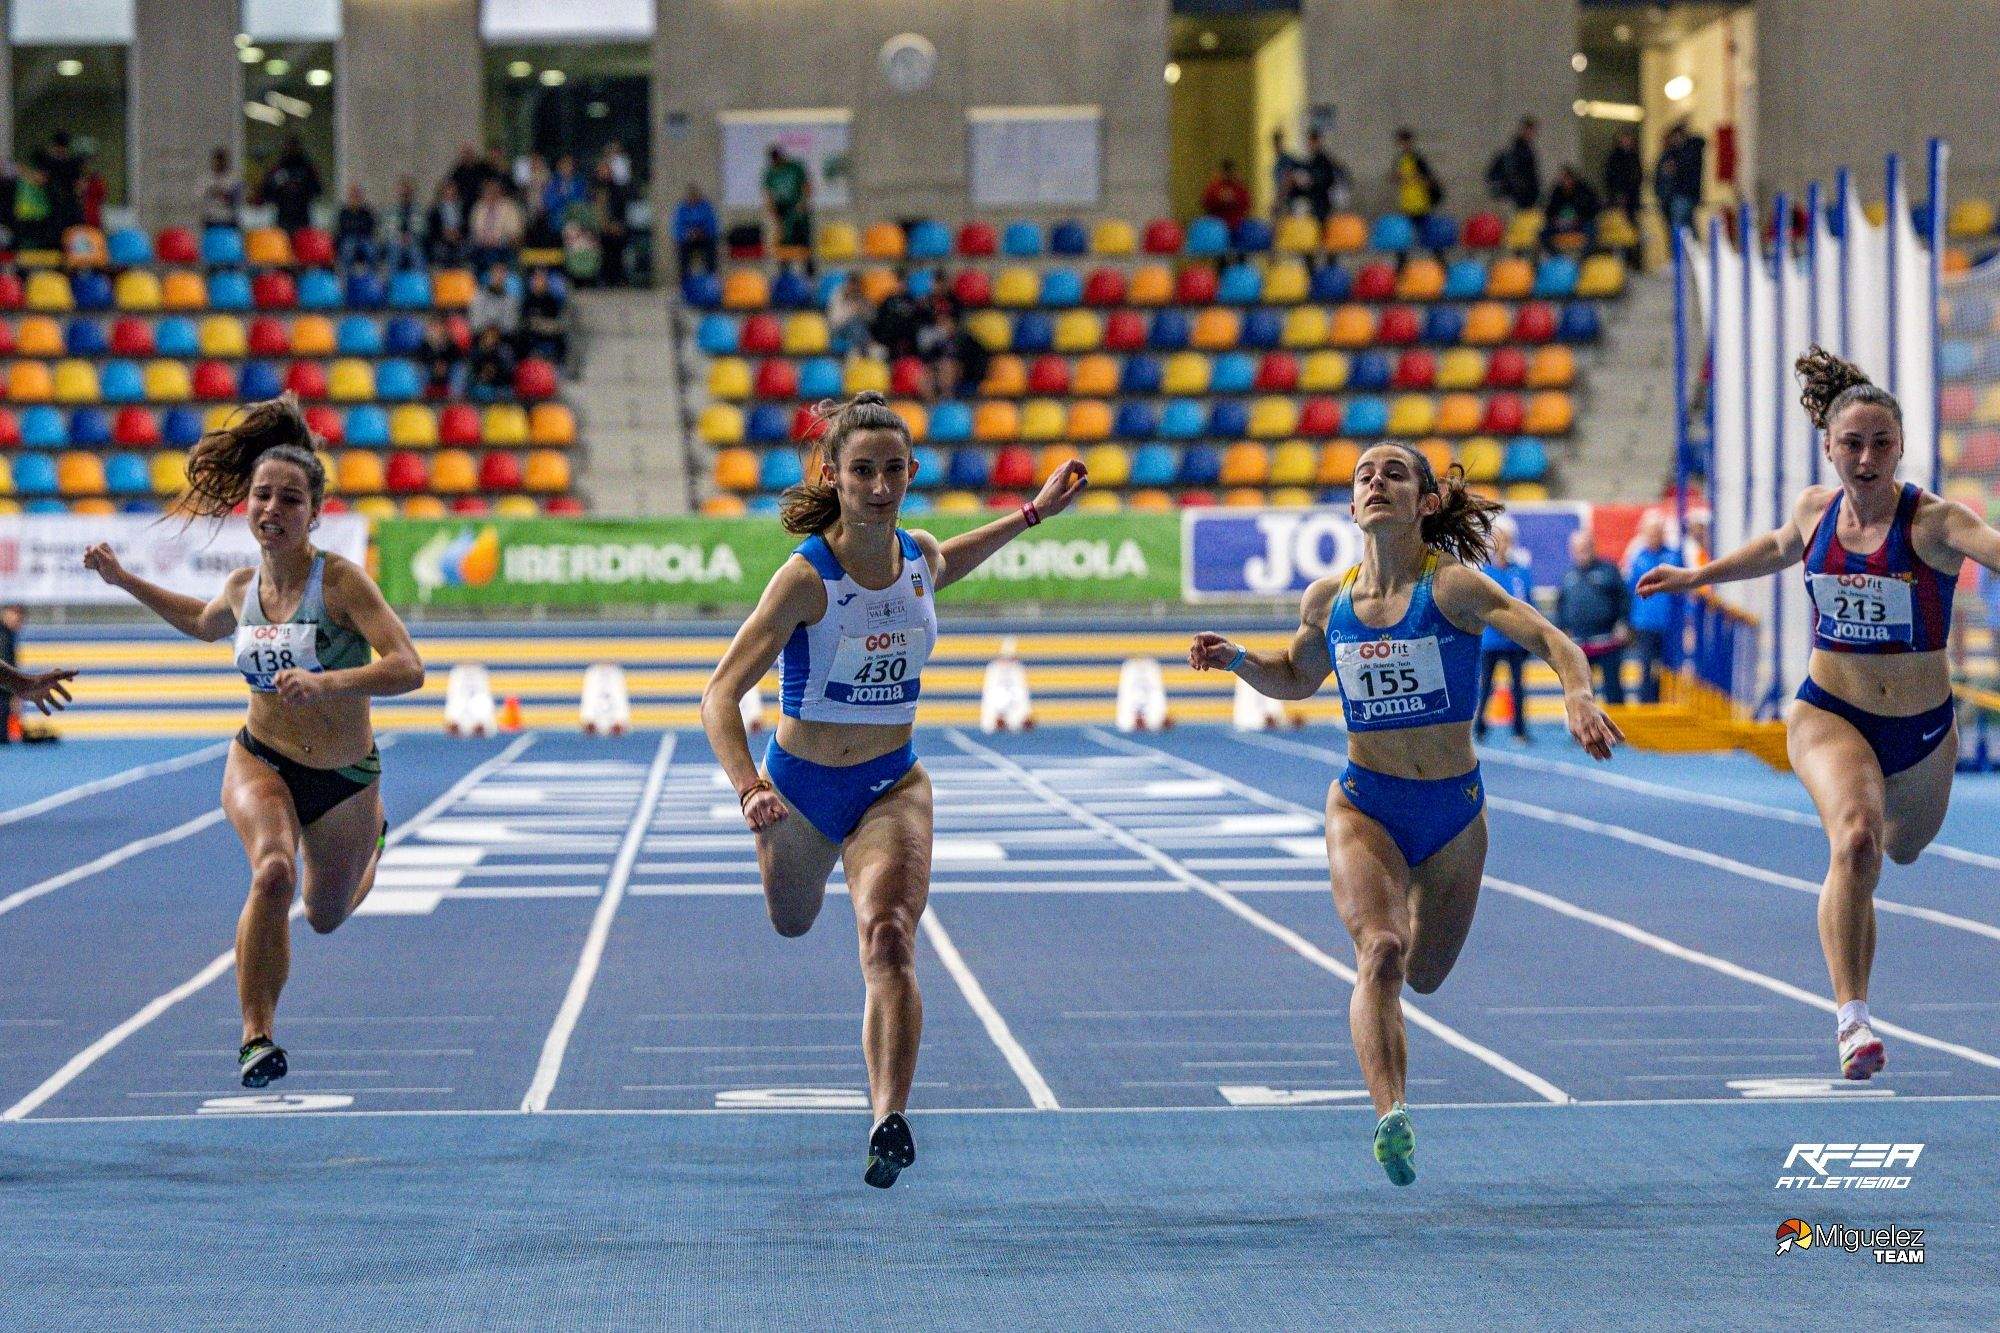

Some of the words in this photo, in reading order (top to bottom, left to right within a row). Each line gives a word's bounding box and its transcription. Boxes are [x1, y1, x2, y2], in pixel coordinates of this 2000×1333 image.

[505, 543, 742, 584] IBERDROLA
[1834, 597, 1886, 621] 213
[866, 633, 905, 651] GOfit
[1833, 621, 1890, 640] Joma
[250, 650, 296, 672] 138
[1360, 641, 1408, 659] GOfit
[854, 658, 907, 683] 430
[846, 685, 904, 702] Joma
[1359, 668, 1419, 697] 155
[1362, 696, 1426, 720] Joma
